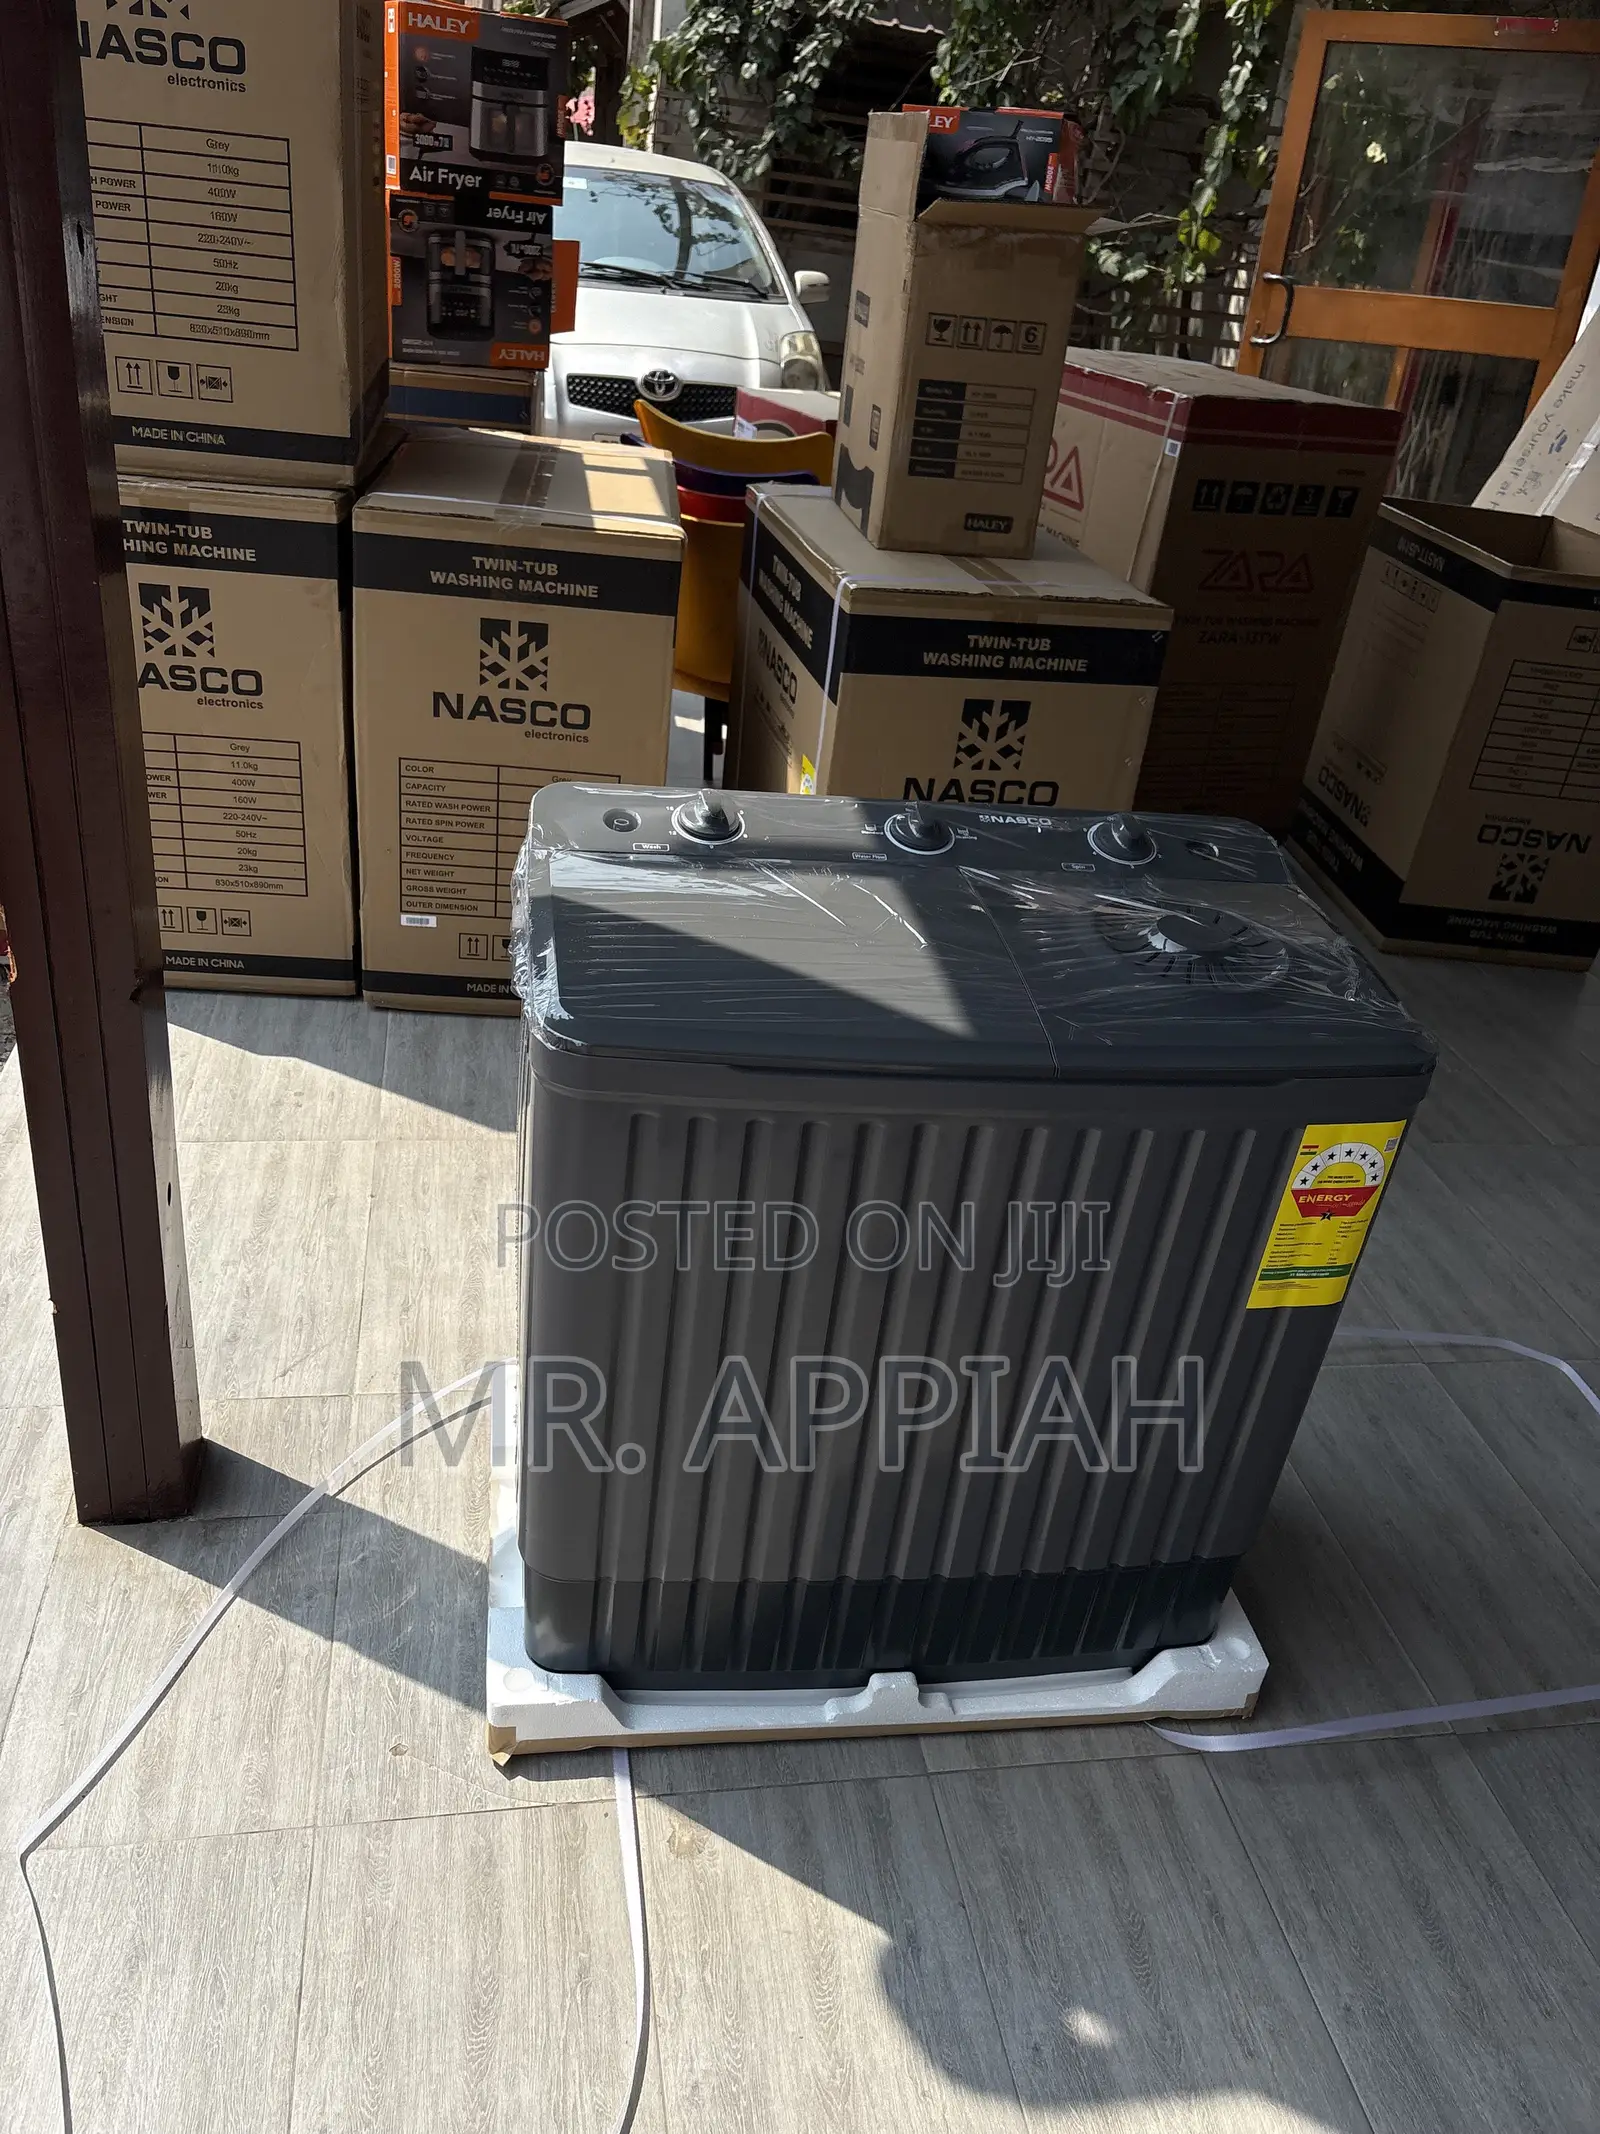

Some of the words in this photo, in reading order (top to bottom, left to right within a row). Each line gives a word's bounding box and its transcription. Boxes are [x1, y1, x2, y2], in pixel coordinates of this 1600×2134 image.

[408, 11, 470, 34] HALEY
[167, 73, 247, 93] electronics
[206, 138, 230, 152] Grey
[100, 177, 136, 189] POWER
[409, 165, 436, 183] Air
[438, 169, 482, 190] Fryer
[208, 187, 237, 199] 400W
[95, 200, 131, 212] POWER
[486, 206, 524, 224] Fryer
[526, 211, 548, 226] Air
[99, 293, 118, 303] GHT
[101, 315, 134, 326] ENSION
[499, 348, 545, 362] HALEY
[1553, 364, 1587, 408] make
[132, 425, 168, 440] MADE
[170, 429, 182, 442] IN
[185, 431, 226, 446] CHINA
[1510, 413, 1555, 479] yourself
[122, 519, 213, 540] TWIN-TUB
[966, 517, 1009, 531] HALEY
[123, 539, 168, 555] HING
[173, 542, 257, 562] MACHINE
[472, 555, 558, 576] TWIN-TUB
[430, 570, 513, 590] WASHING
[518, 579, 599, 598] MACHINE
[967, 634, 1052, 652] TWIN-TUB
[923, 652, 1004, 669] WASHING
[1009, 655, 1088, 672] MACHINE
[763, 634, 797, 704] NASCO
[138, 661, 263, 697] ASCO
[196, 696, 264, 710] electronics
[432, 691, 591, 731] NASCO
[524, 729, 590, 744] electronics
[229, 742, 251, 754] Grey
[230, 760, 259, 772] 11.0kg
[405, 765, 435, 774] COLOR
[146, 774, 171, 783] OWER
[231, 778, 256, 788] 400W
[405, 782, 447, 793] CAPACITY
[902, 777, 1060, 808] NASCO
[1318, 767, 1363, 819] NASCO
[148, 791, 167, 799] WER
[233, 795, 257, 805] 160W
[405, 800, 433, 810] RATED
[435, 802, 460, 811] WASH
[461, 804, 491, 813] POWER
[405, 817, 433, 826] RATED
[435, 819, 454, 828] SPIN
[455, 821, 485, 830] POWER
[990, 815, 1052, 827] NASCO
[235, 830, 257, 839] 50Hz
[406, 834, 444, 844] VOLTAGE
[1477, 824, 1592, 854] NASCO
[237, 847, 258, 857] 20kg
[406, 852, 455, 861] FREQUENCY
[238, 864, 259, 874] 23kg
[406, 868, 422, 877] NET
[423, 869, 455, 879] WEIGHT
[406, 884, 434, 893] GROSS
[436, 886, 467, 896] WEIGHT
[406, 901, 434, 909] OUTER
[435, 902, 479, 912] DIMENSION
[165, 955, 196, 966] MADE
[197, 957, 209, 967] IN
[211, 958, 245, 969] CHINA
[466, 983, 497, 994] MADE
[498, 985, 510, 994] IN
[1298, 1193, 1353, 1204] ENERGY
